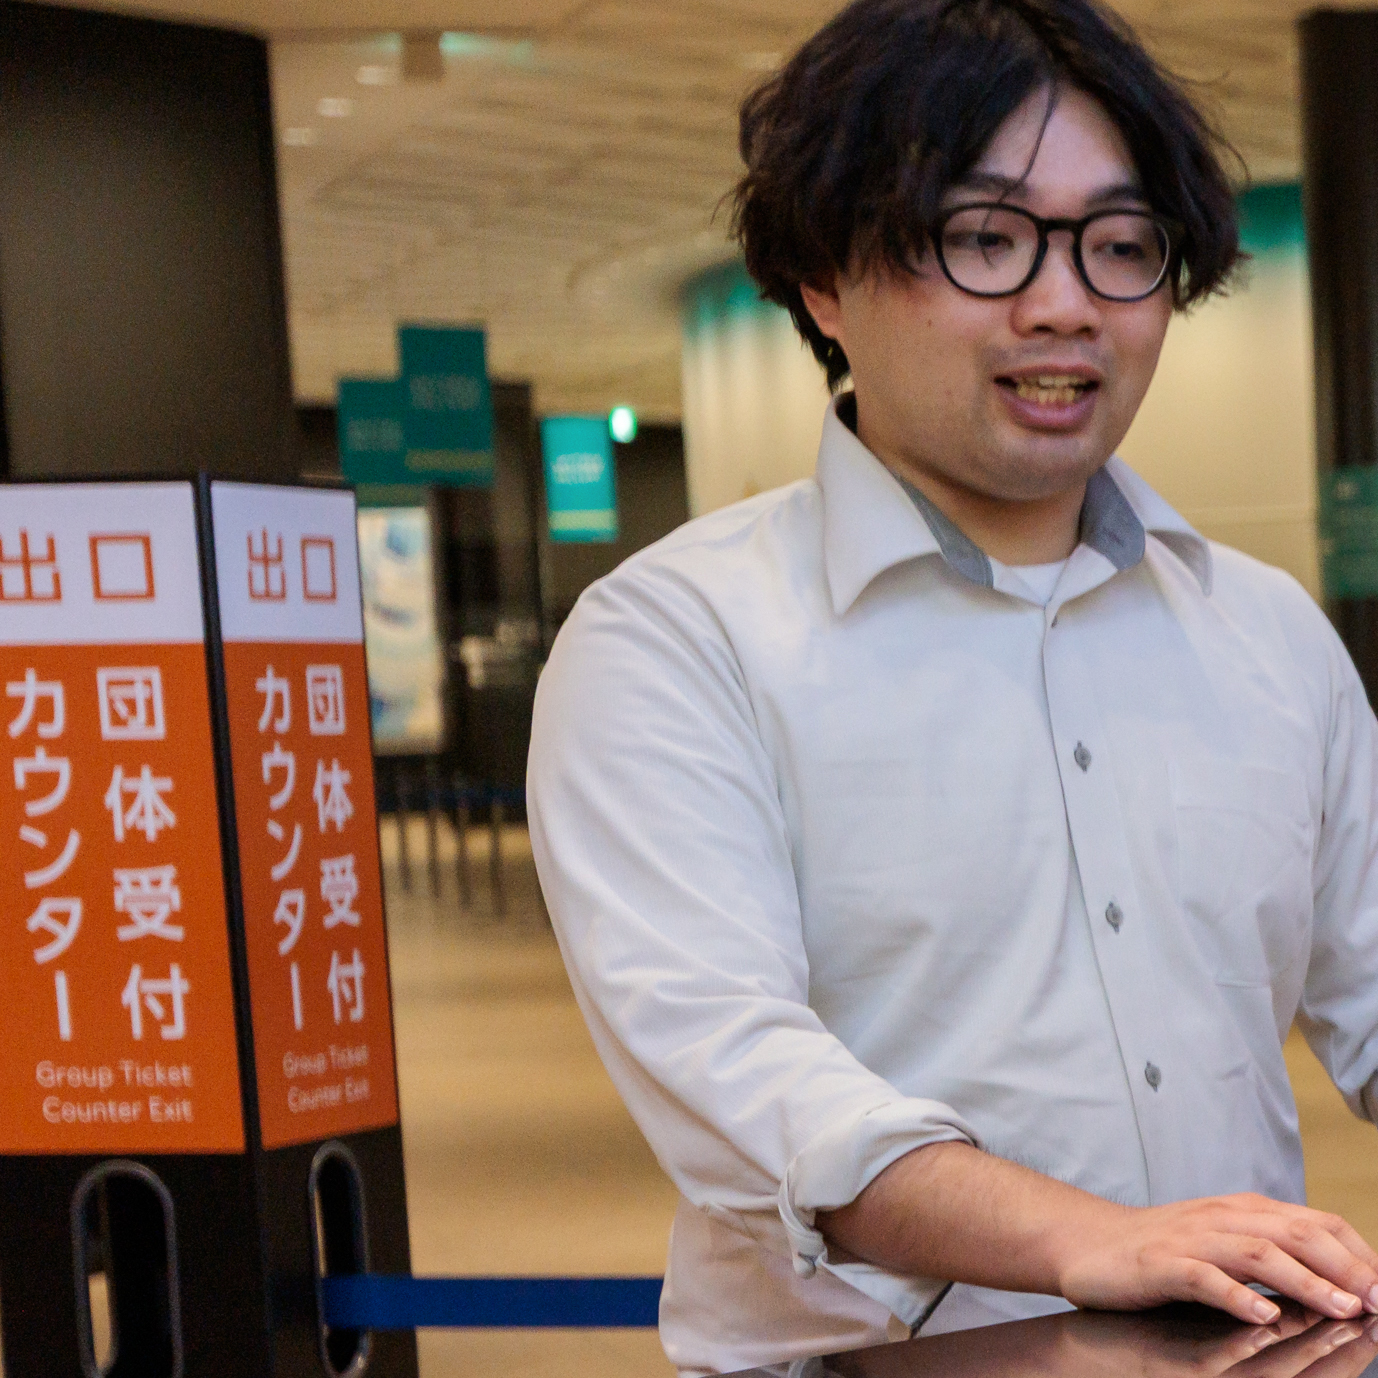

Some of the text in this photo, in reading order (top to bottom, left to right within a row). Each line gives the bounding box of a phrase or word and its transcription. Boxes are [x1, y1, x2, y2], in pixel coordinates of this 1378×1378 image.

[0, 529, 157, 601] 出口
[247, 527, 338, 602] 出口
[6, 668, 82, 1042] カウンター
[96, 666, 190, 1041] 団体受付
[256, 664, 305, 1031] カウンター
[306, 664, 366, 1024] 団体受付
[36, 1058, 193, 1092] Group Ticket
[282, 1043, 369, 1079] Group Ticket
[287, 1076, 370, 1114] Counter Exit
[43, 1095, 194, 1123] Counter Exit
